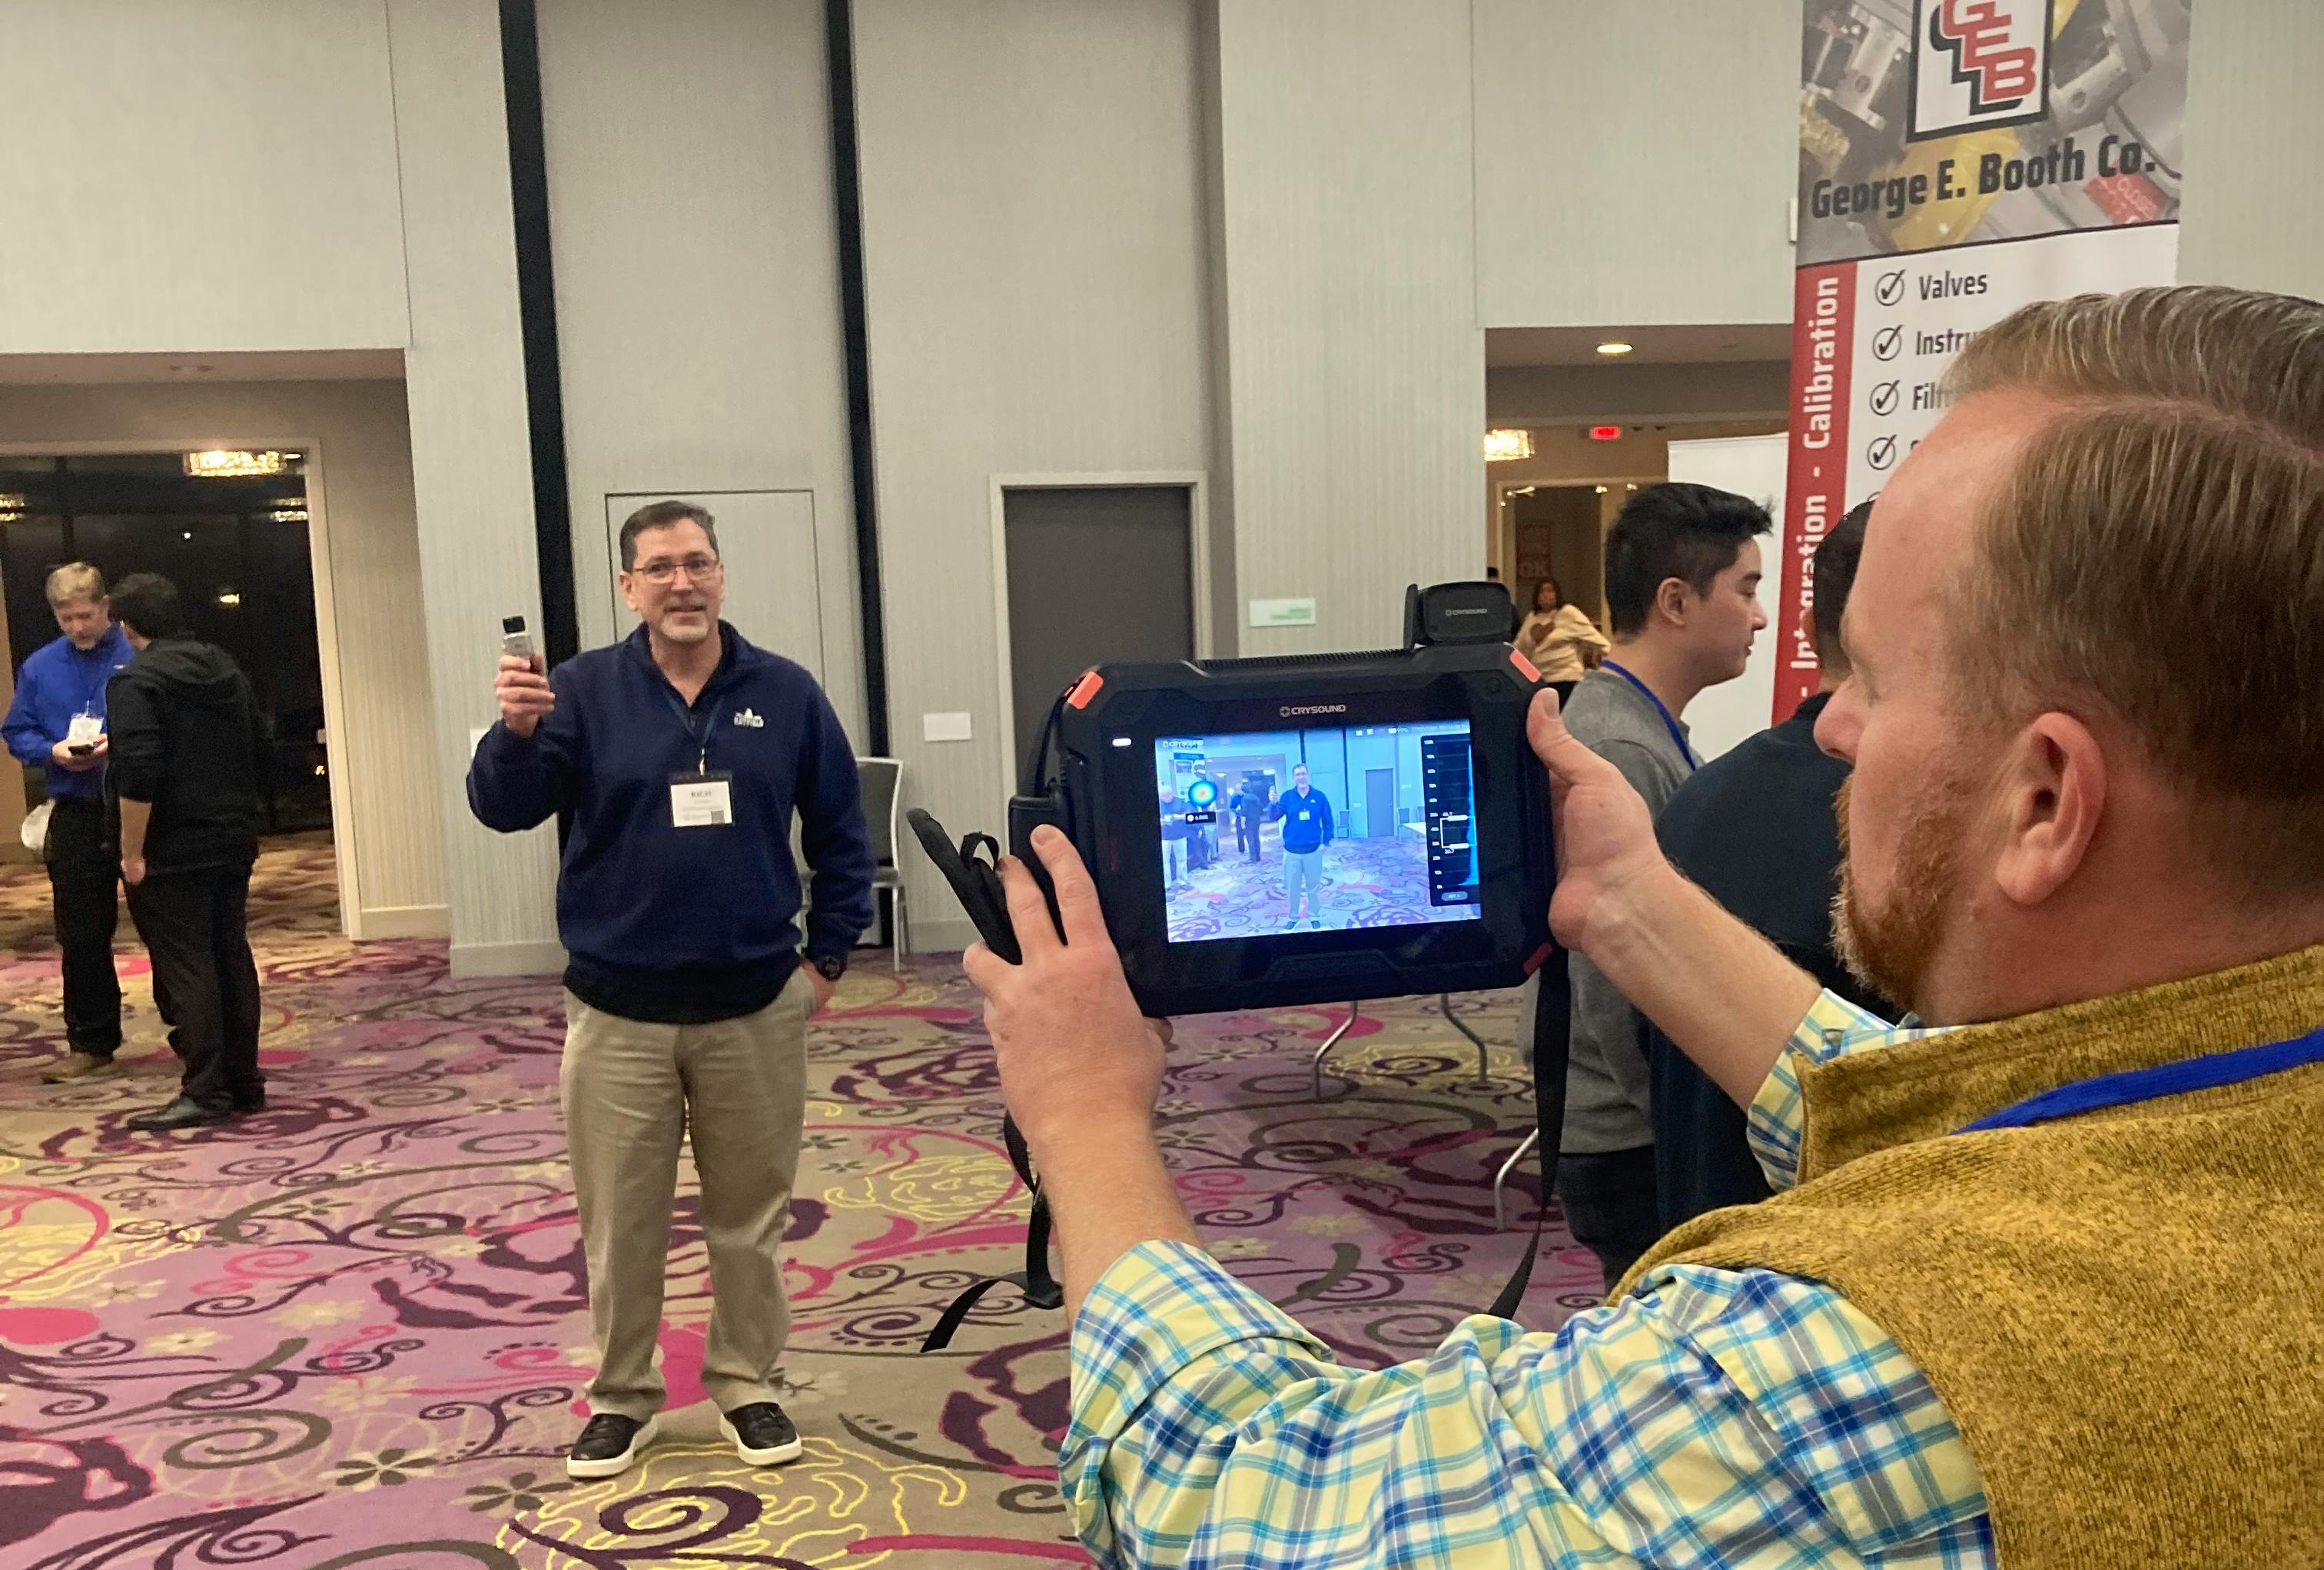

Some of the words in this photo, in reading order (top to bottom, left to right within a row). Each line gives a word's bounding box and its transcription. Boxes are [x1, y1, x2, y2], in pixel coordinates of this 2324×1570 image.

[1812, 174, 1927, 218] George
[1937, 159, 1965, 201] E.
[1979, 136, 2085, 194] Booth
[2097, 134, 2156, 178] Co.
[1919, 270, 1987, 300] Valves
[1803, 277, 1838, 449] Calibration
[1291, 704, 1346, 715] CRYSOUND
